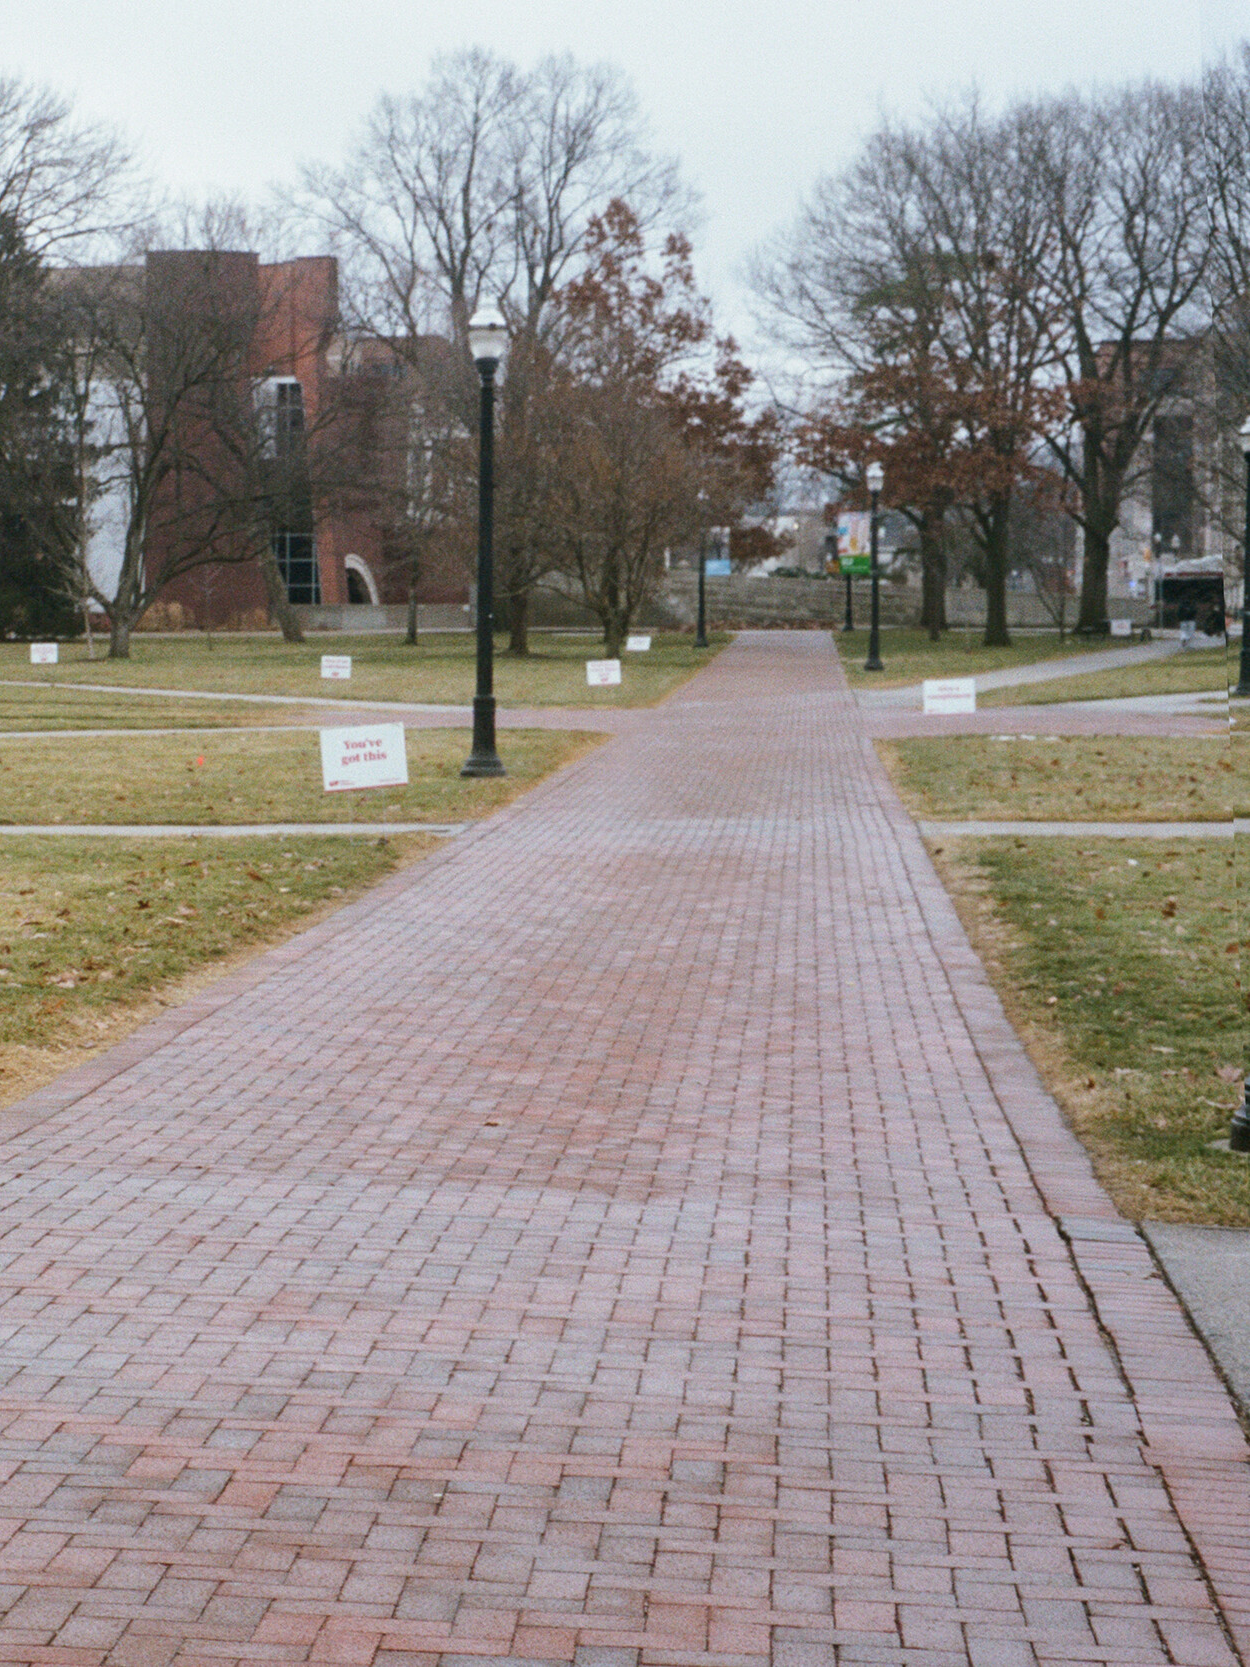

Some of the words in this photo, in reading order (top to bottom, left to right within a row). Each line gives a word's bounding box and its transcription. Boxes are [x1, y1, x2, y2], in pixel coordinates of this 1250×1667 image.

[343, 738, 382, 750] You've
[341, 753, 361, 766] got
[363, 750, 387, 761] this
